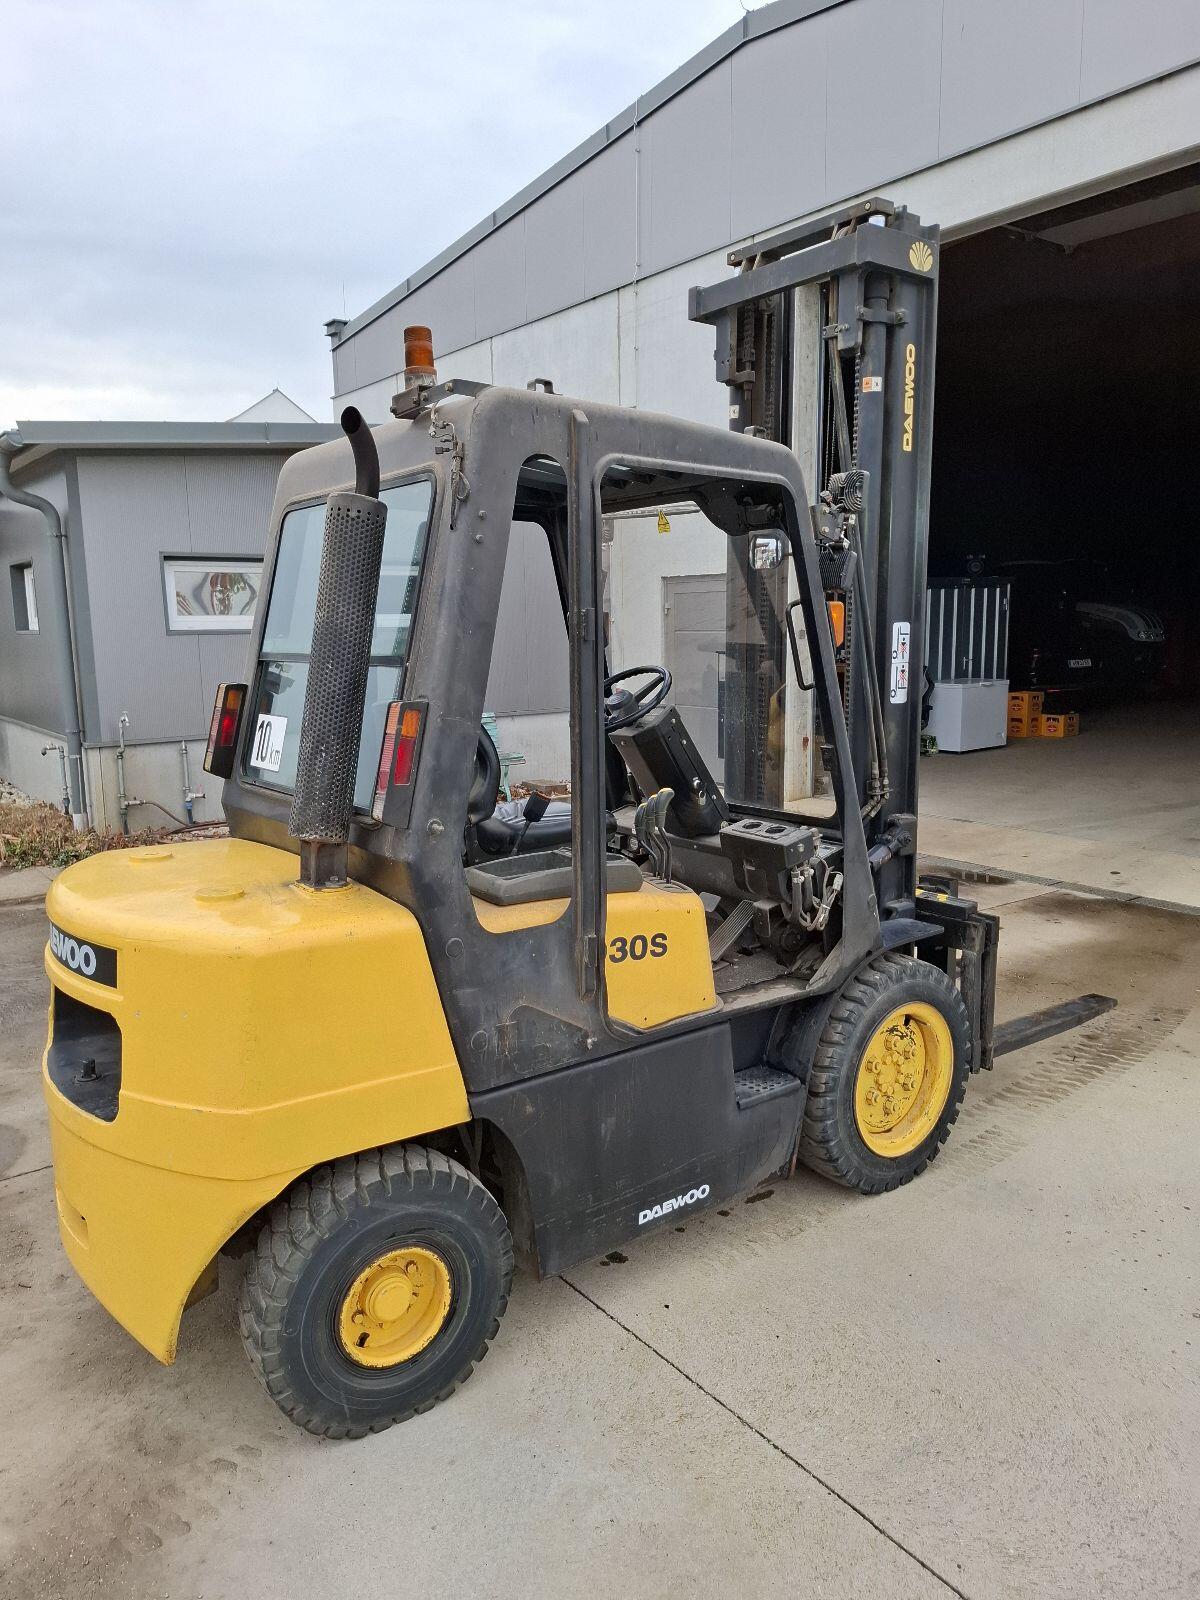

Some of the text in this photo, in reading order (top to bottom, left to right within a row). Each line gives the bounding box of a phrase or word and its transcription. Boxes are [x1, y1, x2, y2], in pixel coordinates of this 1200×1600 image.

[903, 343, 916, 452] DAEWOO
[256, 720, 272, 762] 10
[50, 922, 97, 976] EWOO
[605, 932, 668, 963] 30S
[638, 1184, 710, 1225] DAEWOO
